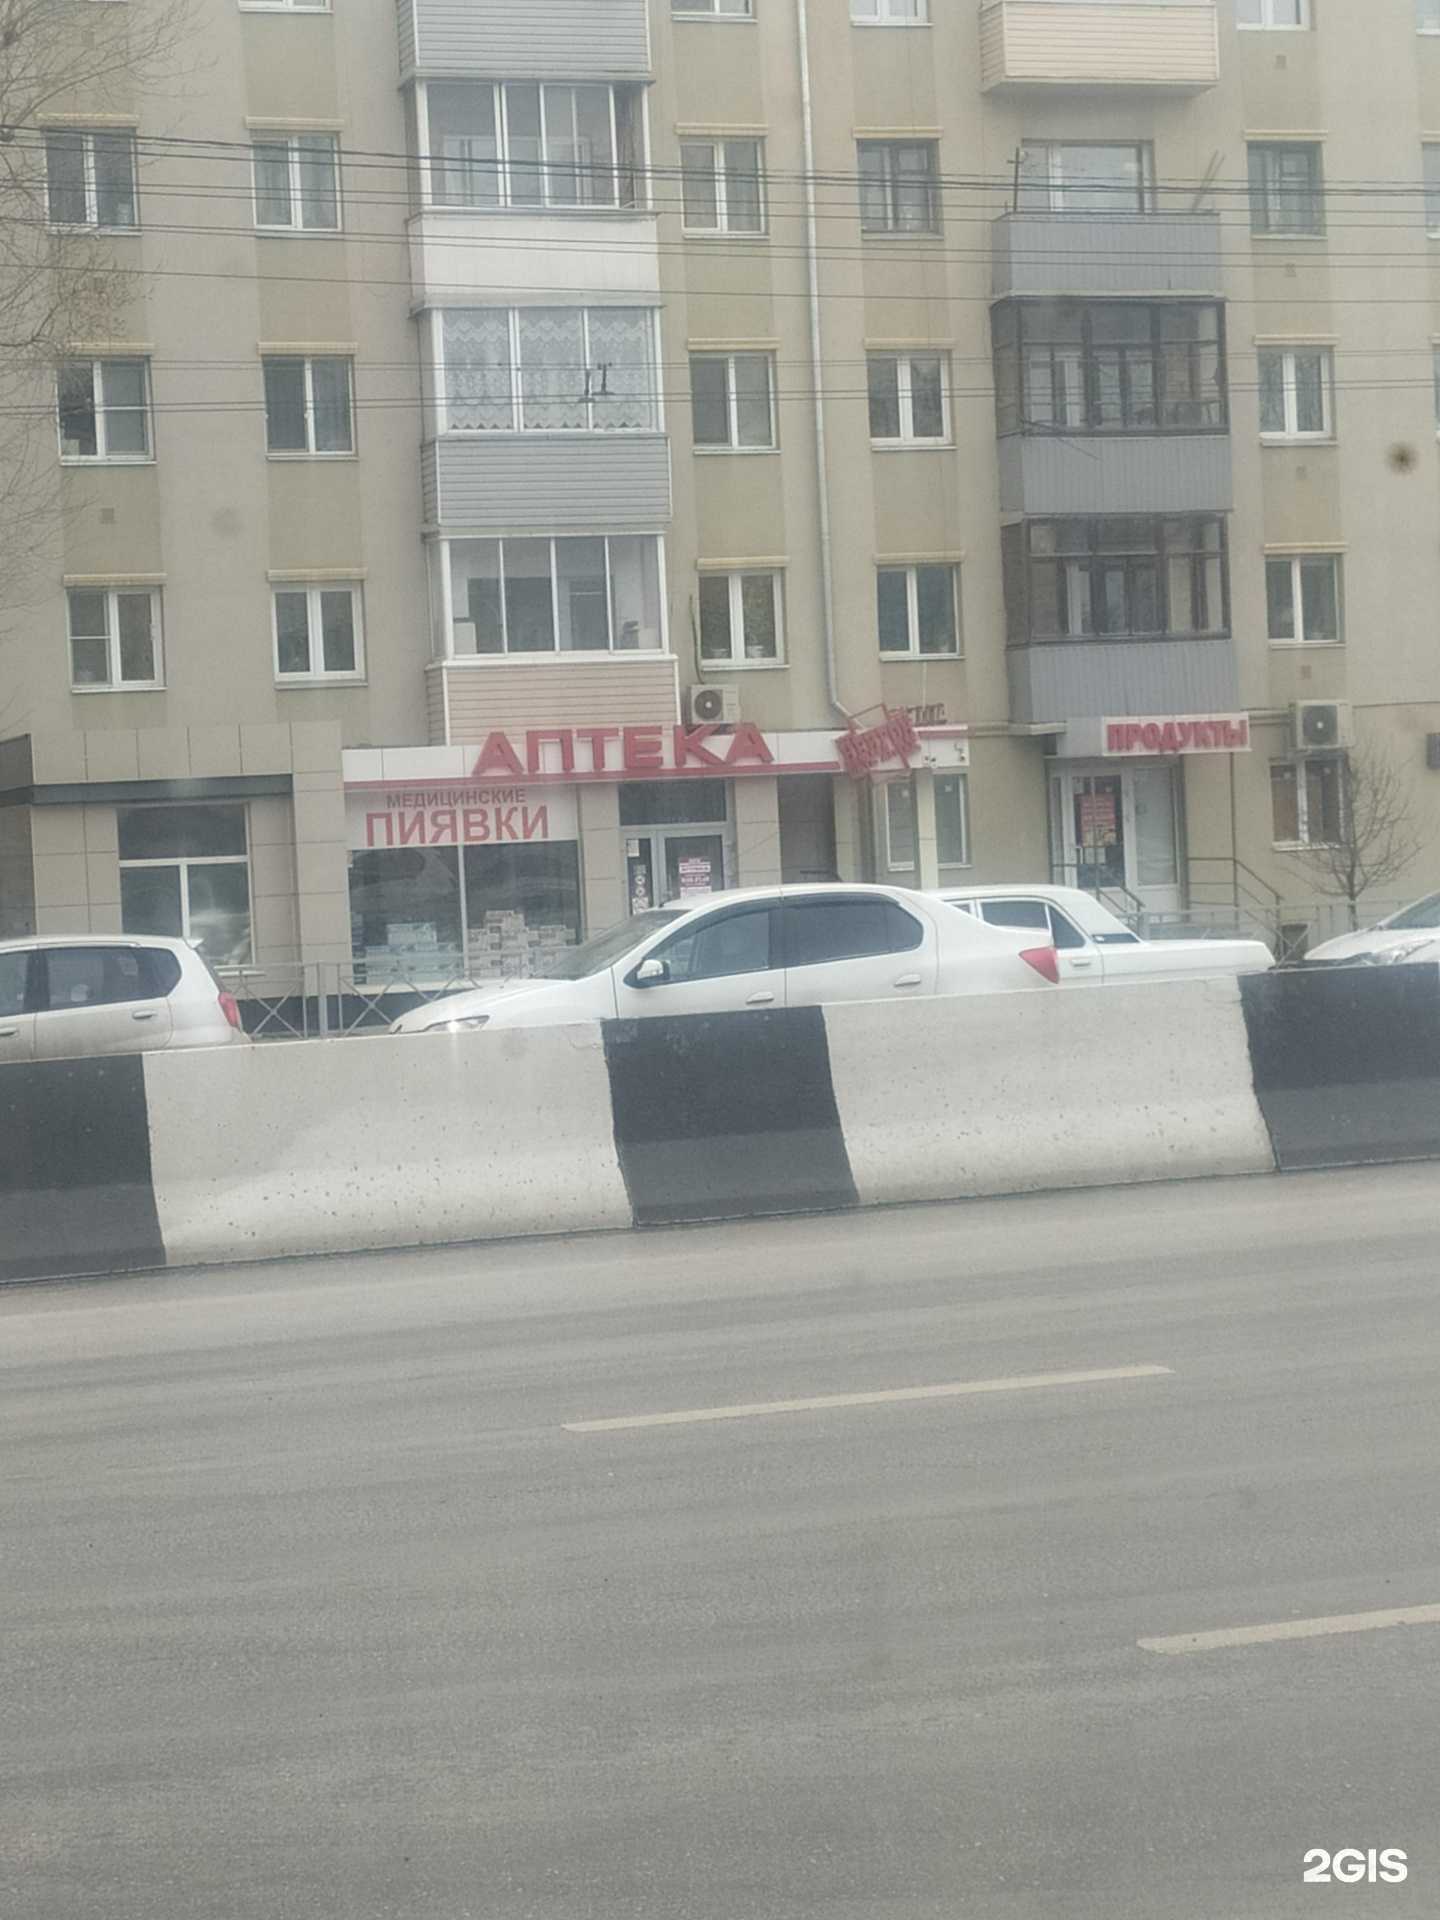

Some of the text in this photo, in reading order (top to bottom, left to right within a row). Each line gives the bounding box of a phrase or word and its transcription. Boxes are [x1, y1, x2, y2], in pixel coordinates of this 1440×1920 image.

[472, 722, 774, 775] АПТЕКА
[1107, 720, 1248, 752] ПРОДУКТЫ
[386, 788, 526, 809] МЕДИЦИНСКИЕ
[366, 805, 549, 847] ПИЯВКИ
